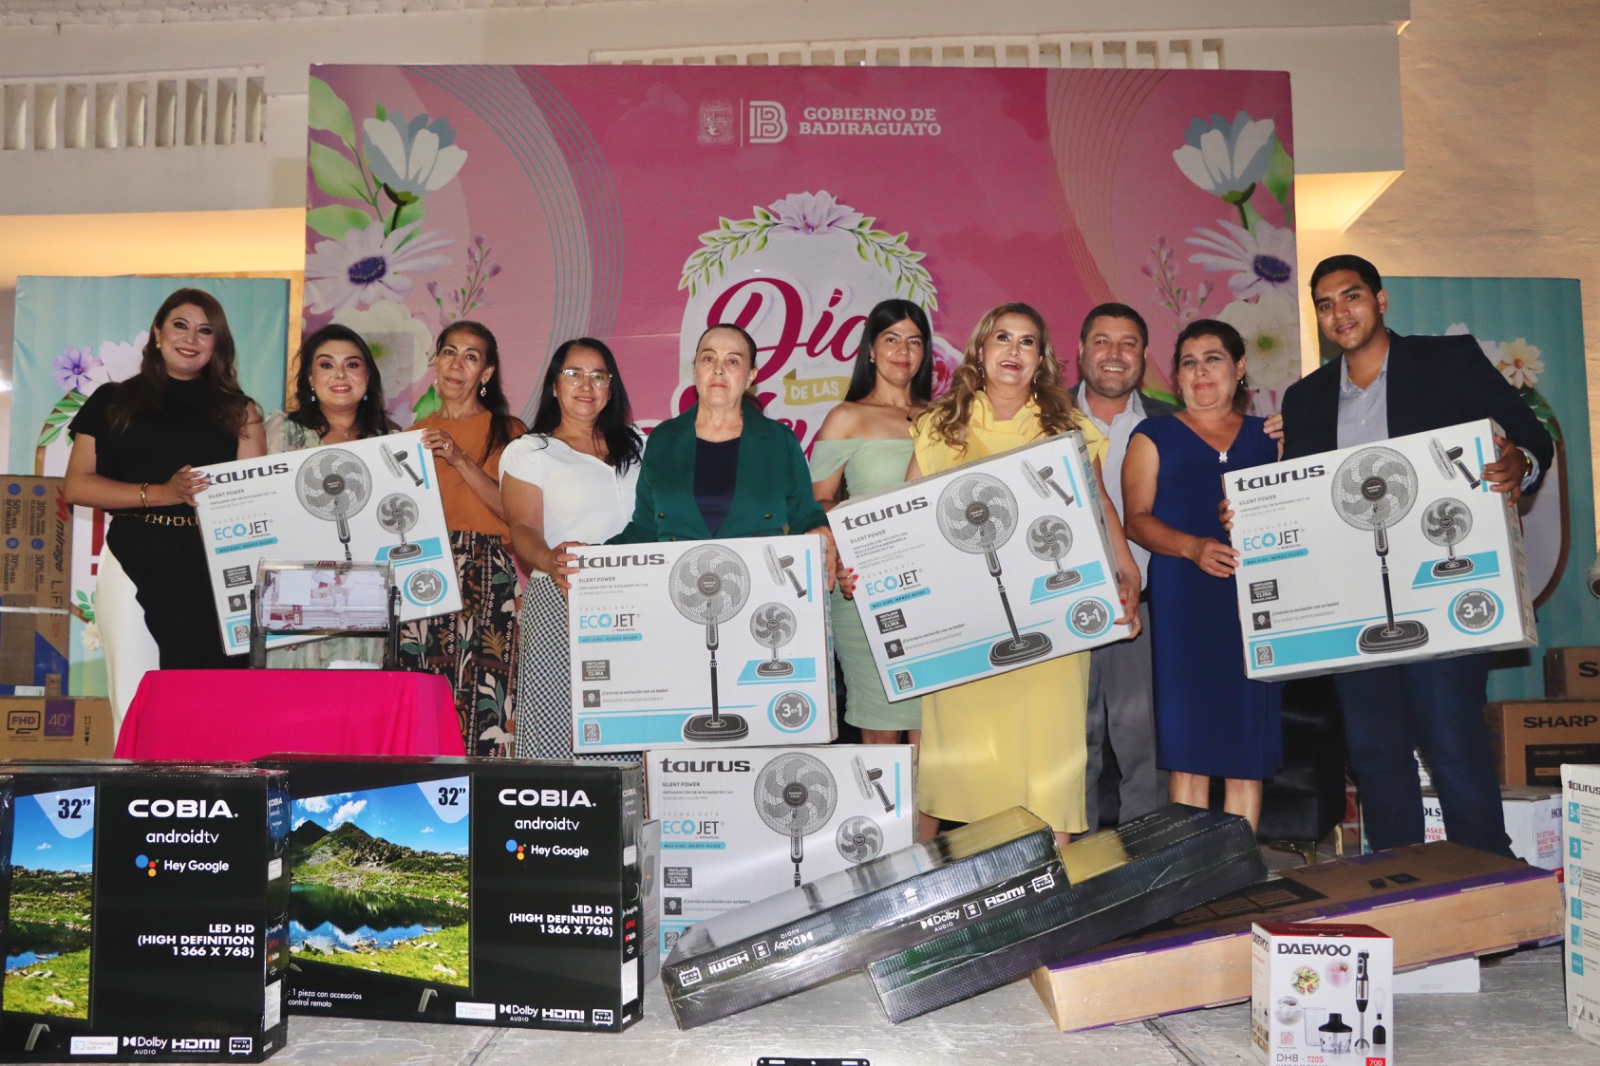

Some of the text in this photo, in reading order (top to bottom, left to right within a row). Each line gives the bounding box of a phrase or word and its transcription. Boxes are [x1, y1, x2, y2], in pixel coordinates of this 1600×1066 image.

[804, 108, 936, 121] GOBIERNO DE
[799, 122, 942, 136] BADIRAGUATO
[791, 380, 839, 400] DE LAS
[205, 463, 289, 486] taurus
[1234, 465, 1326, 492] taurus
[1239, 494, 1277, 506] SILENT POWER
[12, 499, 21, 517] 50%
[36, 500, 46, 519] 30%
[841, 496, 929, 531] taurus
[53, 520, 65, 572] mirage
[1243, 529, 1299, 552] ECOJET
[11, 553, 19, 571] 30%
[35, 554, 45, 574] 30%
[576, 554, 665, 569] taurus
[866, 569, 918, 596] ECOJET
[580, 613, 635, 629] ECOJET
[236, 626, 248, 638] 2
[1258, 646, 1270, 660] 2
[898, 673, 910, 686] 2
[12, 716, 36, 725] FHD
[1523, 715, 1598, 728] SHARP
[586, 724, 597, 737] 2
[659, 758, 751, 773] taurus
[1568, 780, 1600, 795] taurus
[663, 819, 720, 835] ECOJET
[531, 845, 590, 858] Hey Google
[164, 860, 230, 874] Hey Google
[572, 905, 613, 915] LED HD
[509, 913, 543, 924] (HIGH
[547, 915, 613, 926] DEFINITION
[933, 909, 960, 926] Dolby
[209, 924, 255, 934] LED HD
[573, 926, 583, 934] X
[586, 926, 613, 938] 768)
[780, 928, 800, 939] AUDIO
[934, 922, 954, 932] AUDIO
[138, 935, 255, 947] (HIGH DEFINITION
[666, 932, 677, 946] 2
[774, 936, 801, 952] Dolby
[1252, 931, 1270, 953] DAEWOO
[210, 947, 220, 956] X
[224, 947, 255, 958] 768)
[1277, 943, 1352, 957] DAEWOO
[709, 953, 750, 975] HDMI
[298, 989, 316, 998] pieza
[330, 992, 363, 1000] accesorios
[288, 998, 310, 1006] control
[512, 1005, 539, 1018] Dolby
[542, 1008, 585, 1020] HDMI
[138, 1036, 168, 1050] Dolby
[171, 1039, 221, 1050] HDMI
[1277, 1053, 1299, 1062] DHB
